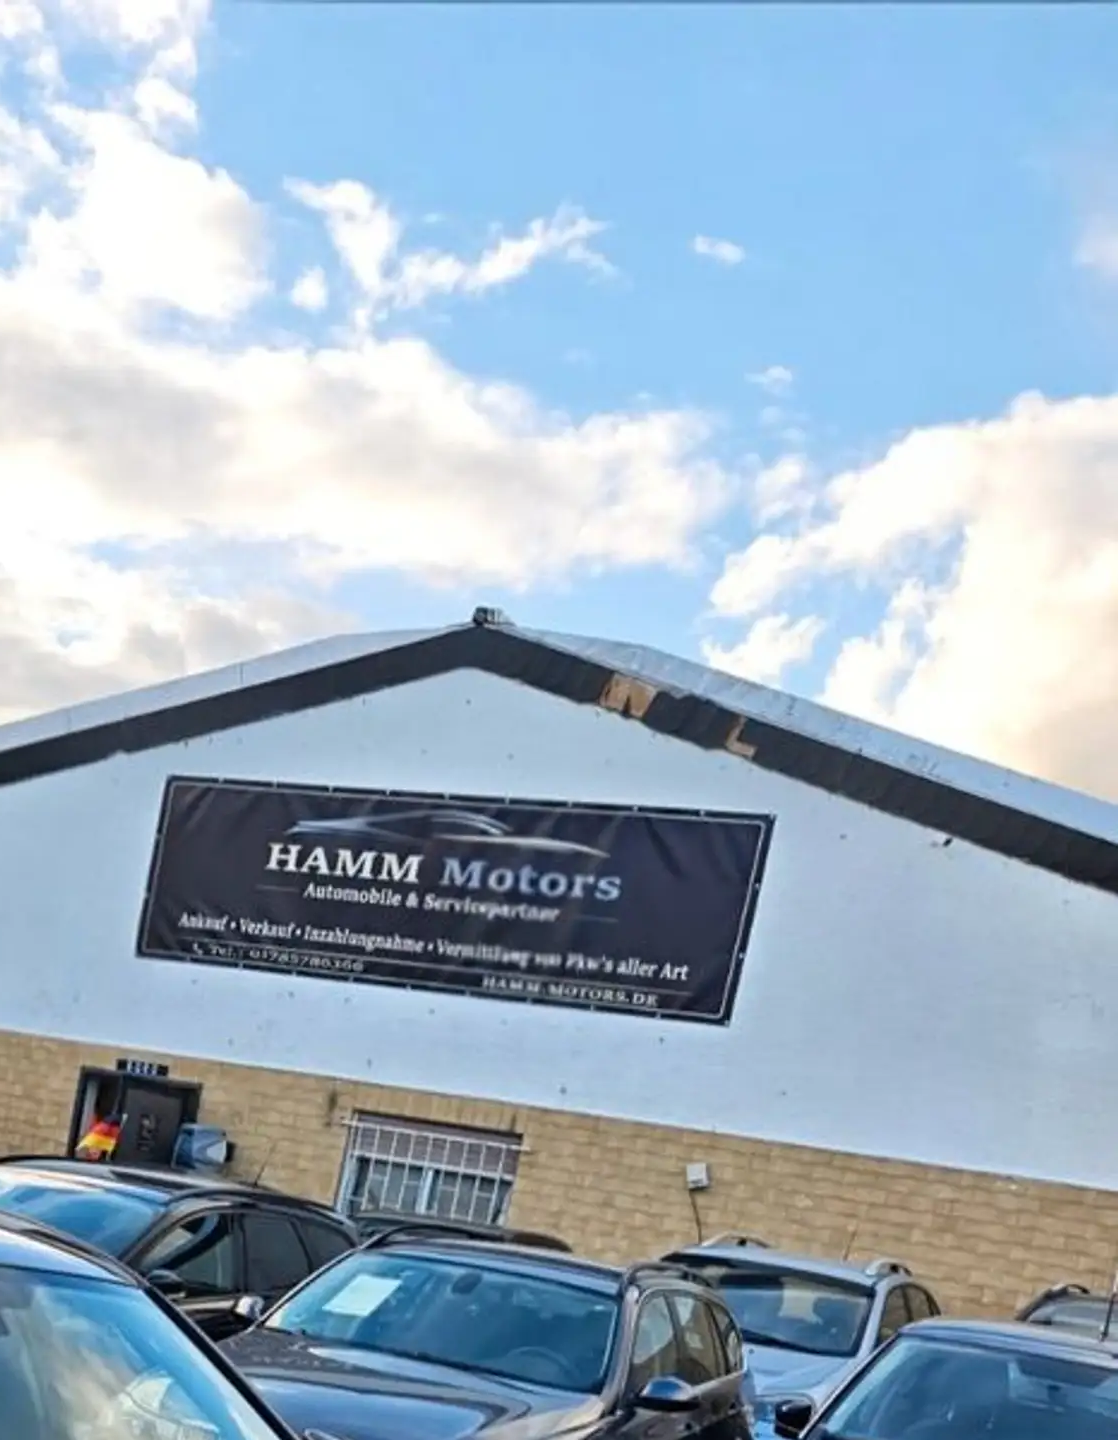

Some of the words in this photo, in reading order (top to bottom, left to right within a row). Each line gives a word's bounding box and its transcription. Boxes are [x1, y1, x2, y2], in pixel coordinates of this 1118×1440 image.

[264, 842, 425, 884] HAMM
[438, 857, 622, 901] Motors
[302, 882, 402, 907] Automobile
[405, 892, 419, 907] &
[423, 893, 563, 922] Servicepartner
[178, 912, 229, 932] Ankauf
[239, 917, 296, 939] Verkauf
[616, 957, 660, 979] aller
[659, 961, 690, 981] Art
